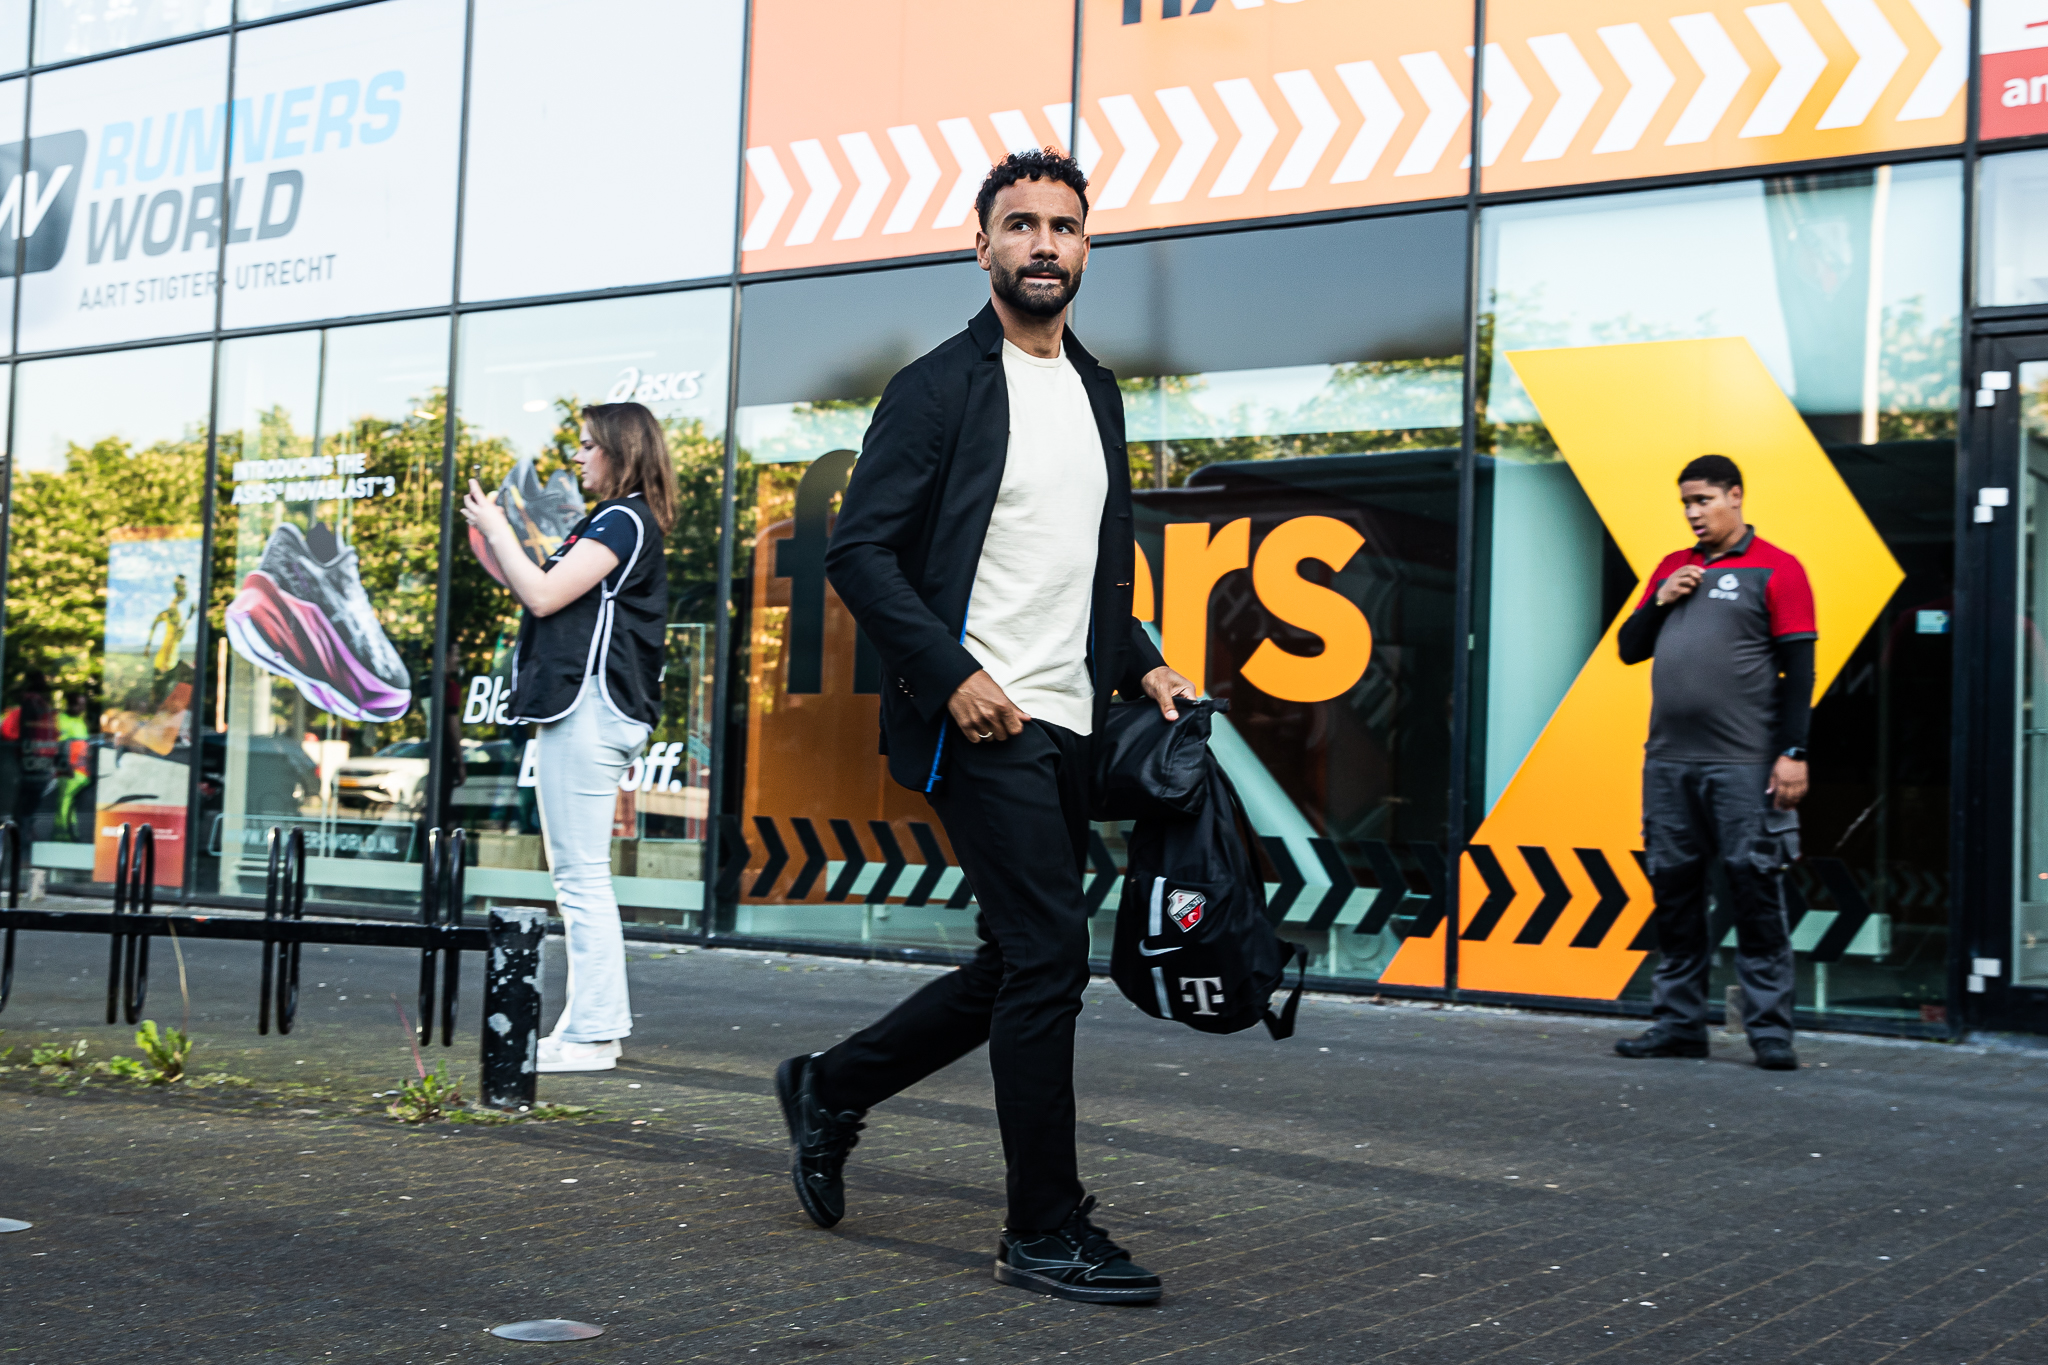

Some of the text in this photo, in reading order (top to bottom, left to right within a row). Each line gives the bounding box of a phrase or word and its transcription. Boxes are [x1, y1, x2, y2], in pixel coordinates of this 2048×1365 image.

[93, 69, 406, 190] RUNNERS
[86, 169, 304, 266] WORLD
[78, 253, 338, 312] AART STIGTER UTRECHT
[233, 453, 367, 481] INTRODUCING THE
